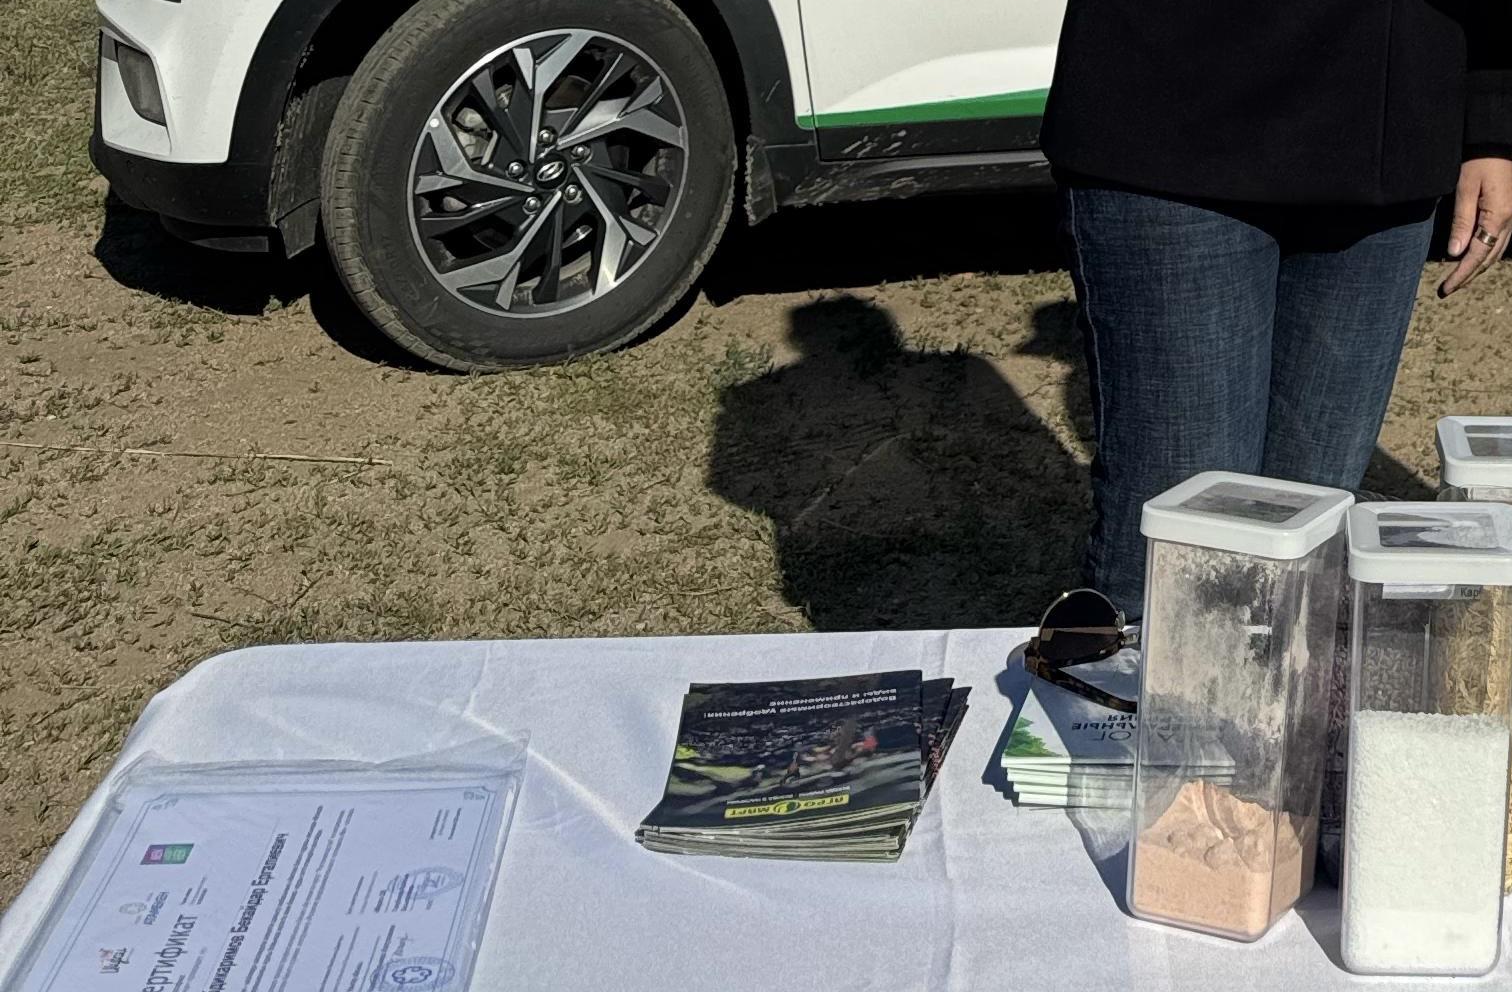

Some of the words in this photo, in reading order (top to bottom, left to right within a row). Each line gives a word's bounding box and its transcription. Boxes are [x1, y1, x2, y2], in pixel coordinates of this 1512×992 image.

[1460, 587, 1481, 599] Кар
[142, 914, 198, 992] ертификат
[202, 934, 245, 992] дикаримов
